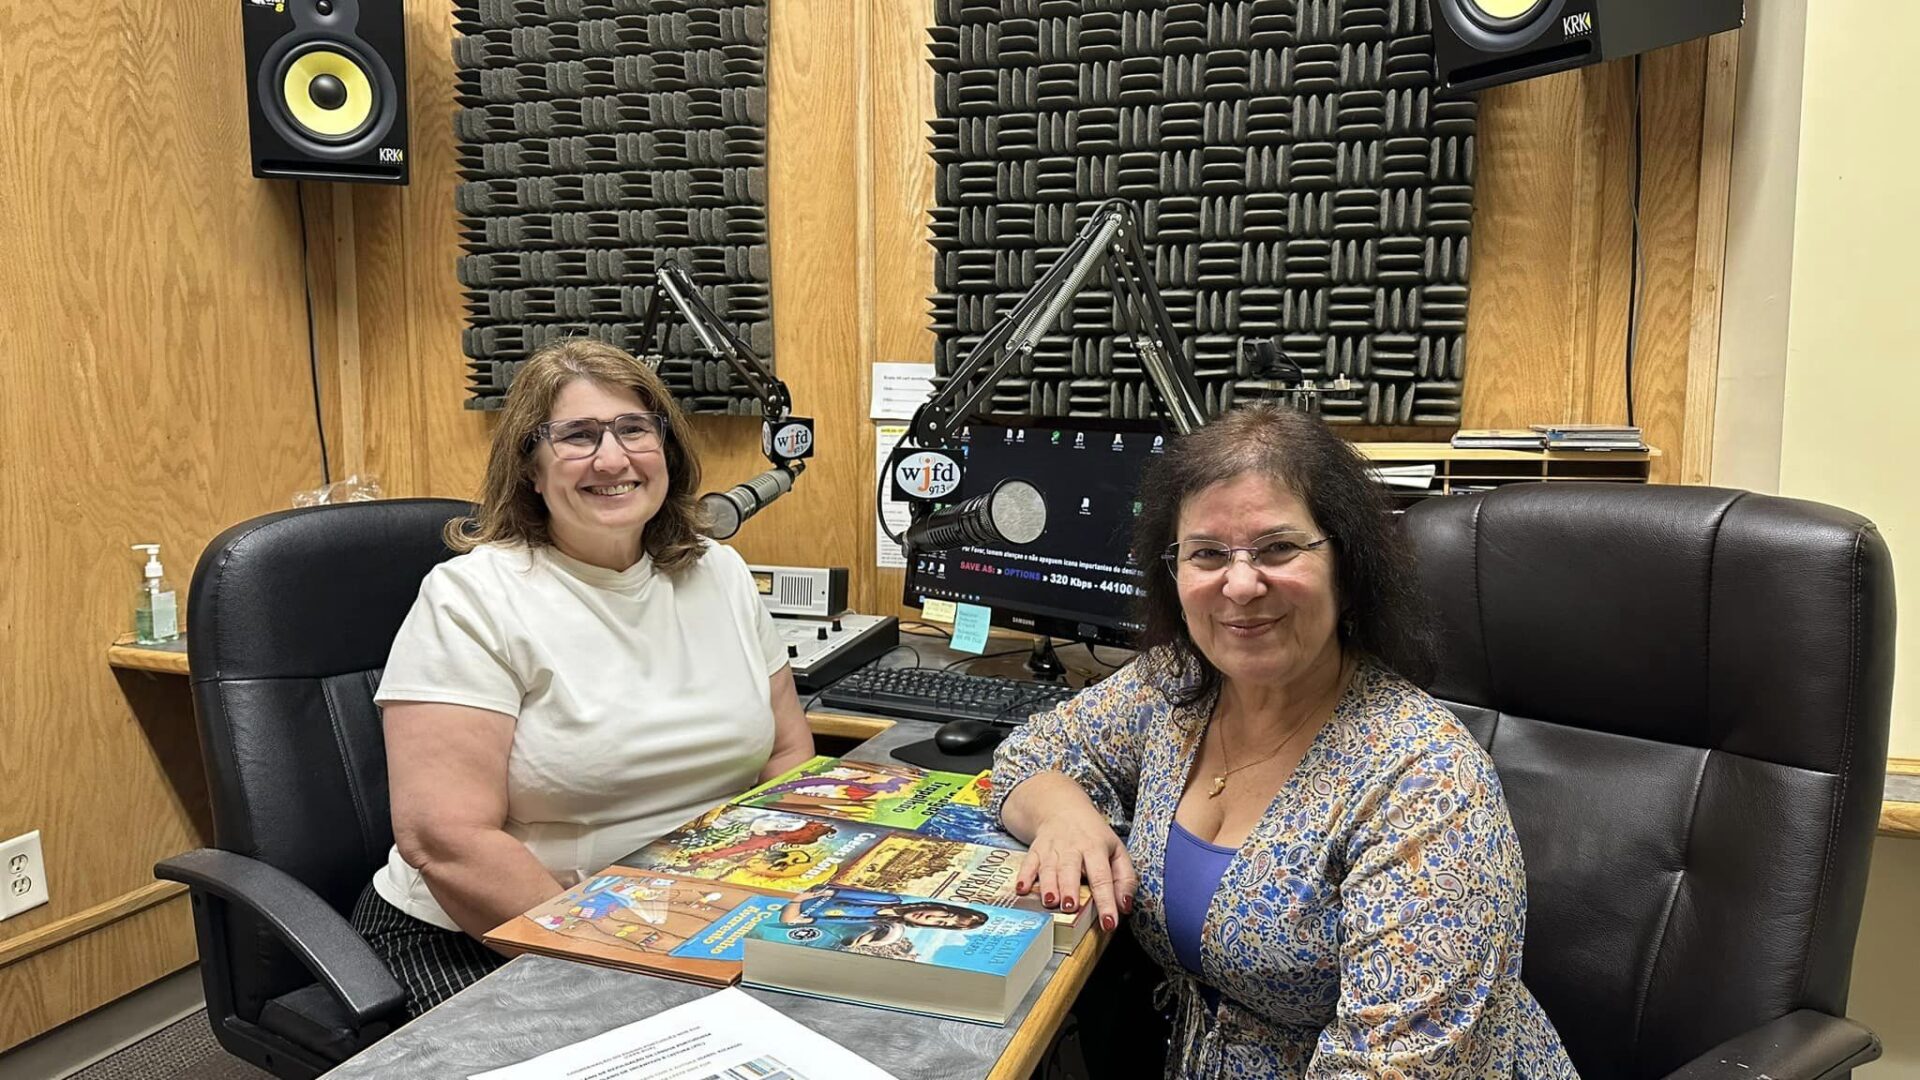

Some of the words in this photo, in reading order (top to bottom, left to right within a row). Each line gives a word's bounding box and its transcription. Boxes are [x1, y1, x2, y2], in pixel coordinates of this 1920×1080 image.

[1563, 12, 1588, 36] KRK
[379, 148, 400, 161] KRK
[777, 429, 808, 453] wjfd
[901, 458, 954, 492] wjfd
[960, 561, 980, 572] SAVE
[982, 565, 995, 574] AS:
[1004, 568, 1040, 581] OPTIONS
[1050, 573, 1068, 585] 320
[1070, 577, 1092, 590] Kbps
[1100, 580, 1133, 595] 44100
[1012, 616, 1035, 626] SAMSUNG
[998, 867, 1013, 875] O
